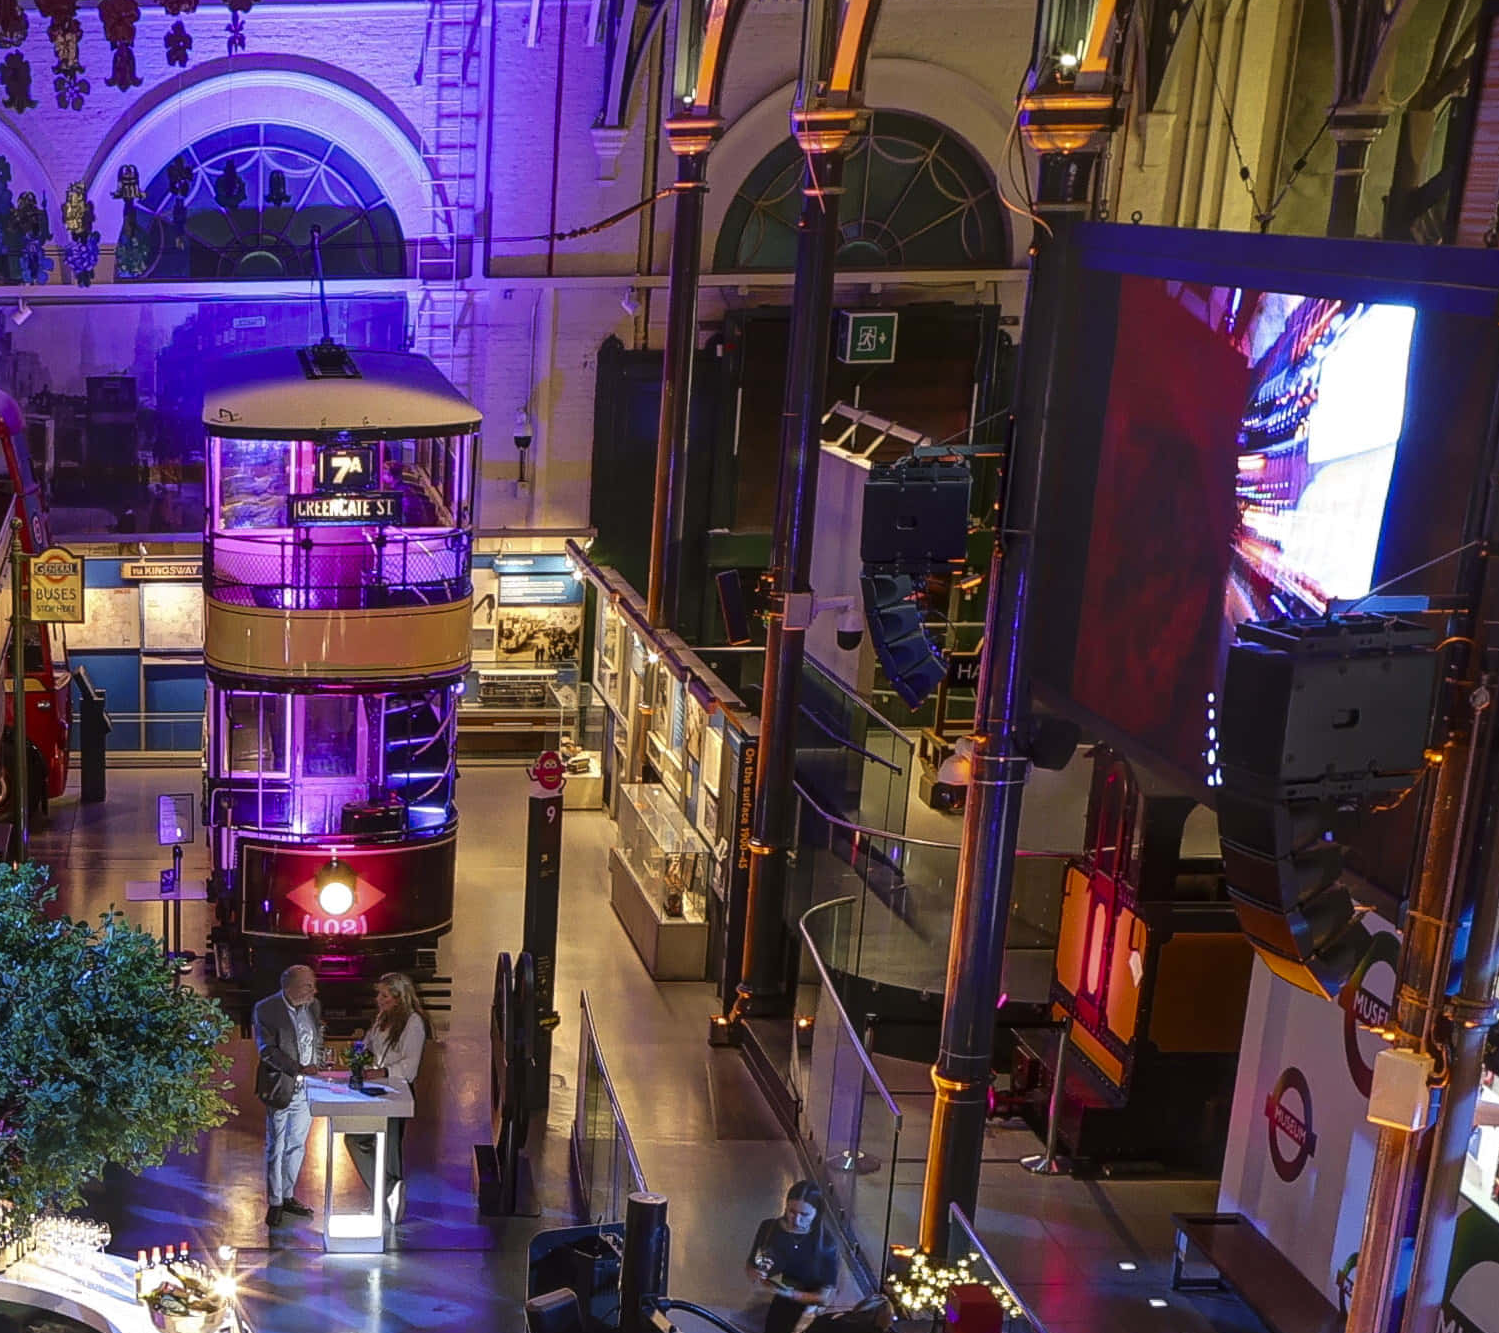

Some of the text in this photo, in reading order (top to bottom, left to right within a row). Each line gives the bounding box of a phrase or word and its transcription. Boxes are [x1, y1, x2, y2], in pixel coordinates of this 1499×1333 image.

[144, 565, 199, 576] KINGSWAY
[36, 588, 77, 601] BUSES
[545, 805, 557, 824] 9
[740, 788, 754, 825] surface
[1274, 1104, 1307, 1141] MUSEUM
